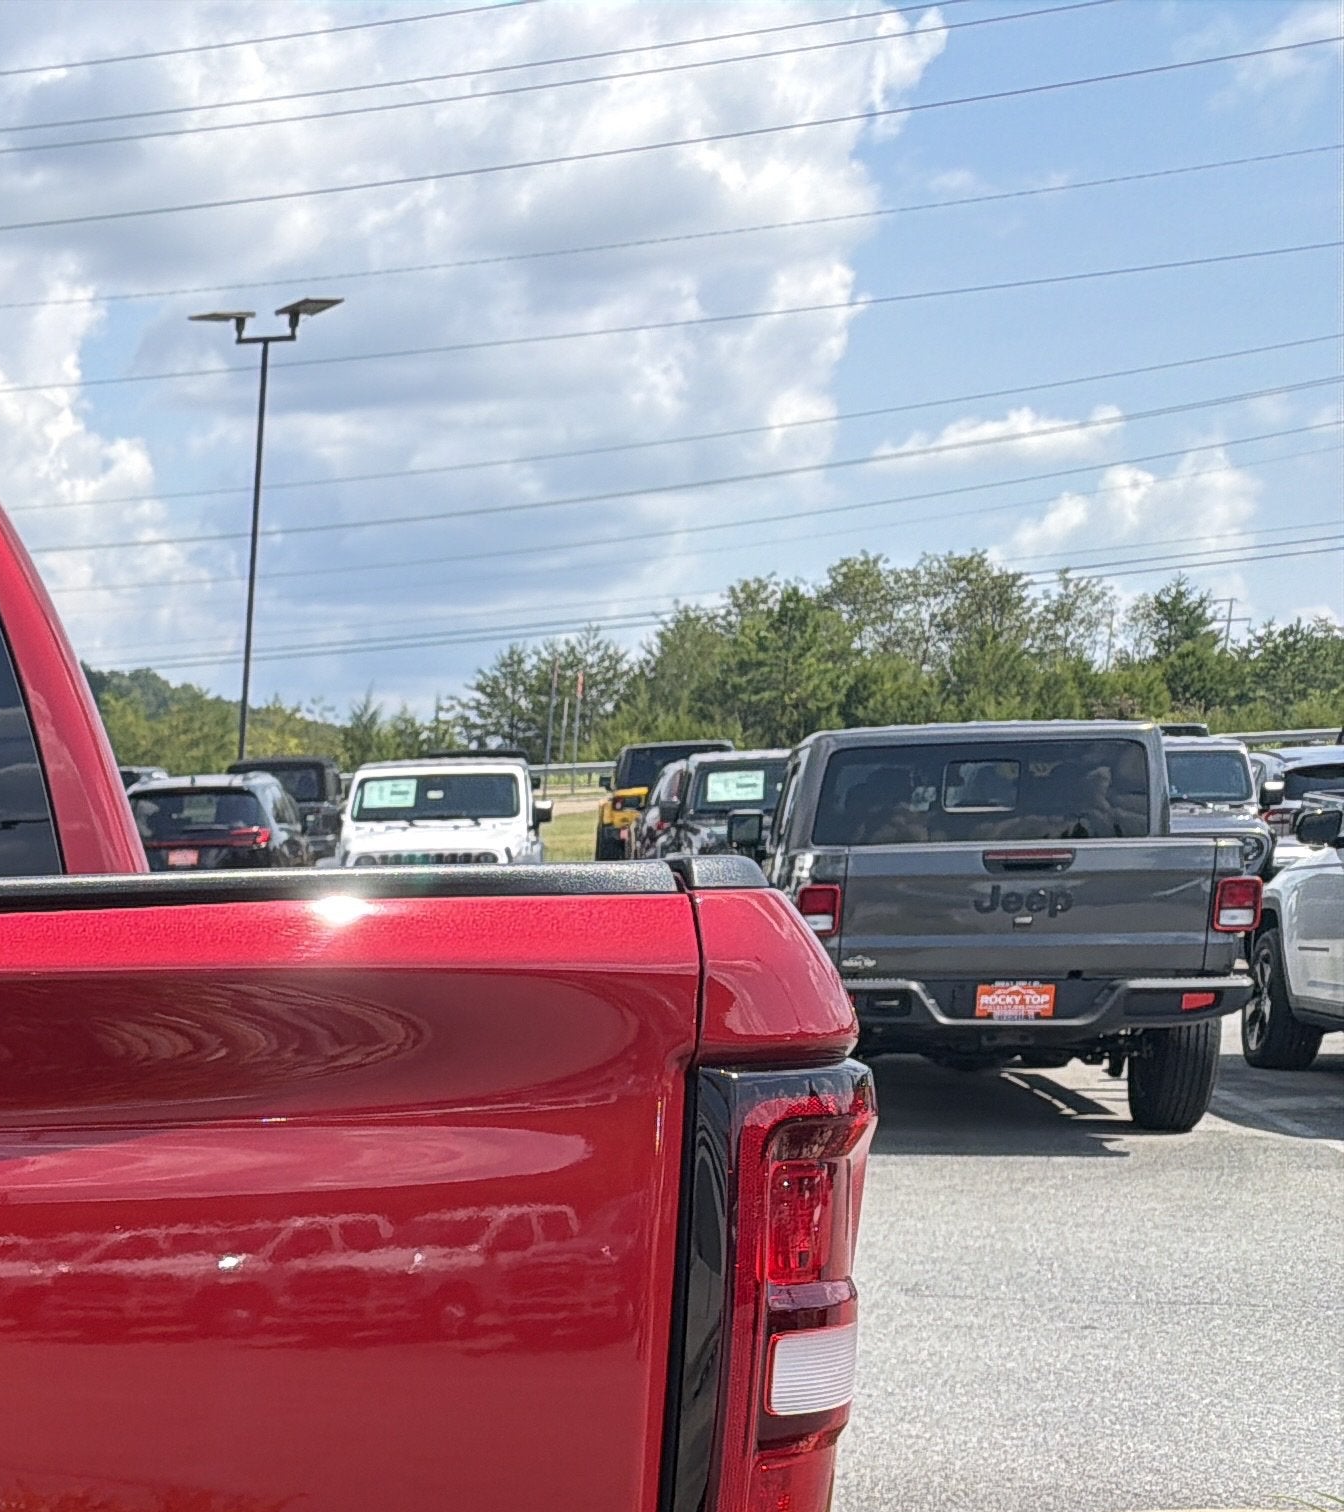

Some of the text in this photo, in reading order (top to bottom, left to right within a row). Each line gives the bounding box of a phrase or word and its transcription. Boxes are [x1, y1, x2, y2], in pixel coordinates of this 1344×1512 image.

[974, 884, 1073, 918] Jeep
[980, 995, 1050, 1005] ROCKY TOP
